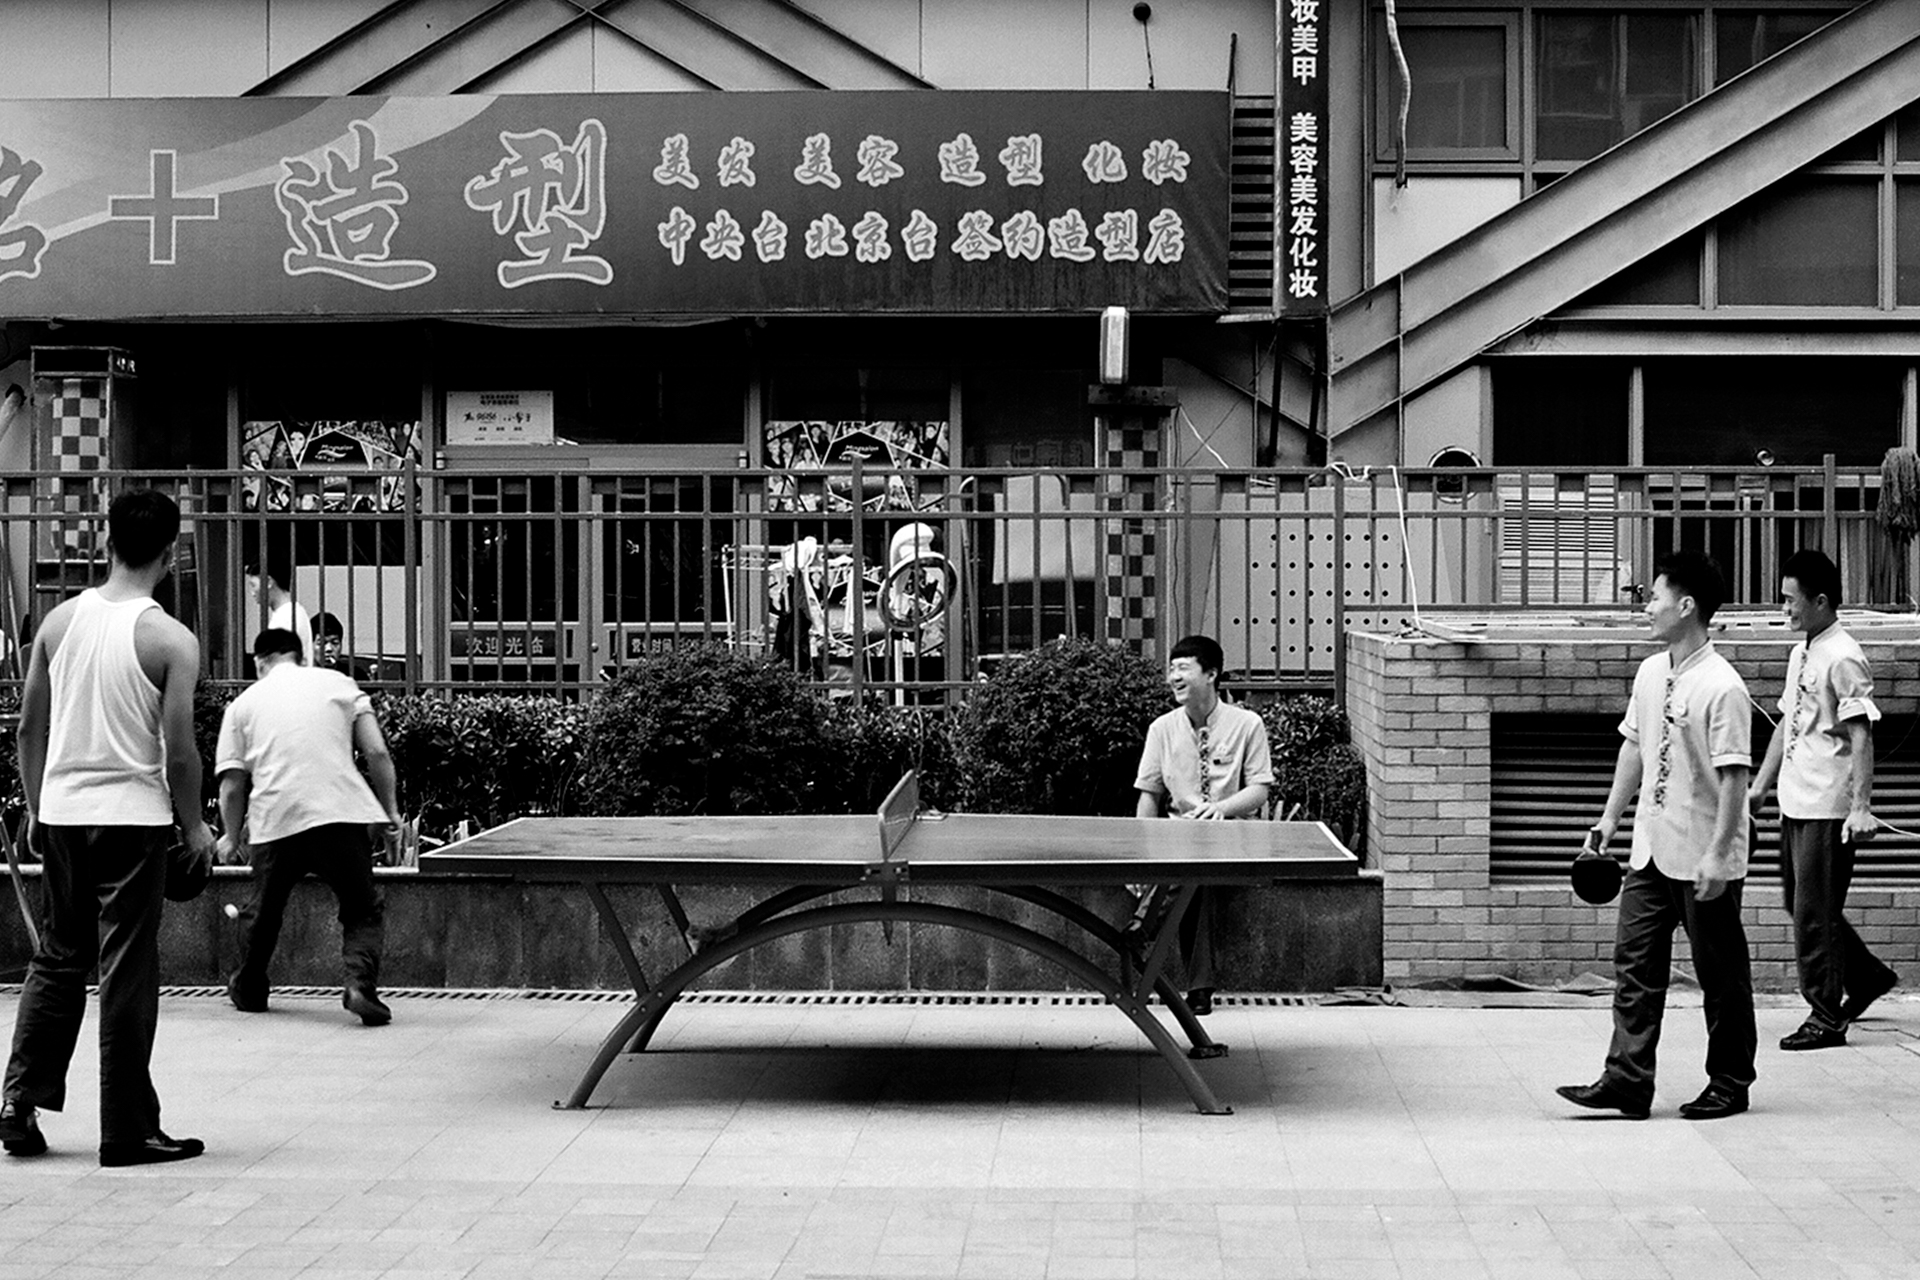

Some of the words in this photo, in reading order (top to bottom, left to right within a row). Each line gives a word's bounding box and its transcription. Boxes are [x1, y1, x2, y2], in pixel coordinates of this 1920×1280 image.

[1290, 0, 1319, 86] 妆美甲
[653, 133, 757, 190] 美发
[1289, 112, 1319, 299] 美容美发化妆
